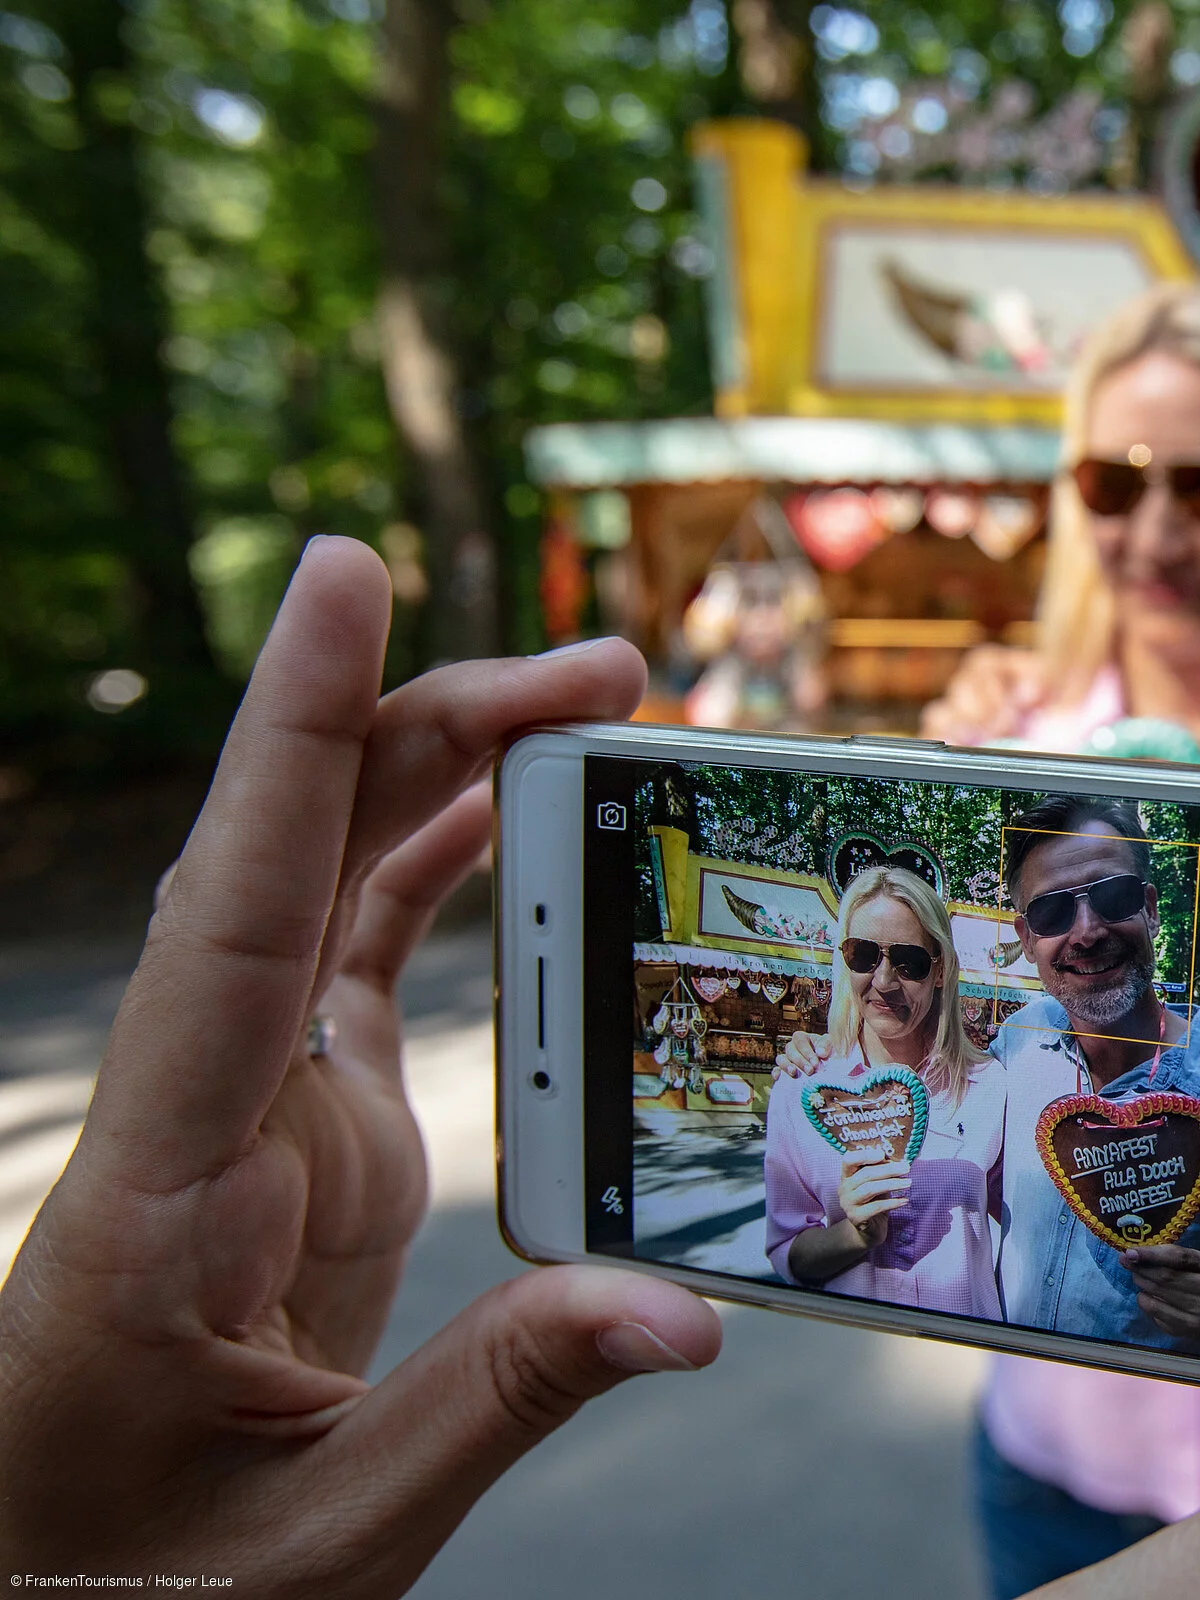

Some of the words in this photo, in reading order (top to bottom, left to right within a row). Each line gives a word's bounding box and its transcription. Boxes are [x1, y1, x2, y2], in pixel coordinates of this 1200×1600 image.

[723, 956, 783, 971] Makronen
[819, 1102, 912, 1127] Forchheimer
[1073, 1133, 1158, 1169] ANNAFEST
[1103, 1167, 1137, 1191] ALLA
[1099, 1180, 1176, 1214] ANNAFEST
